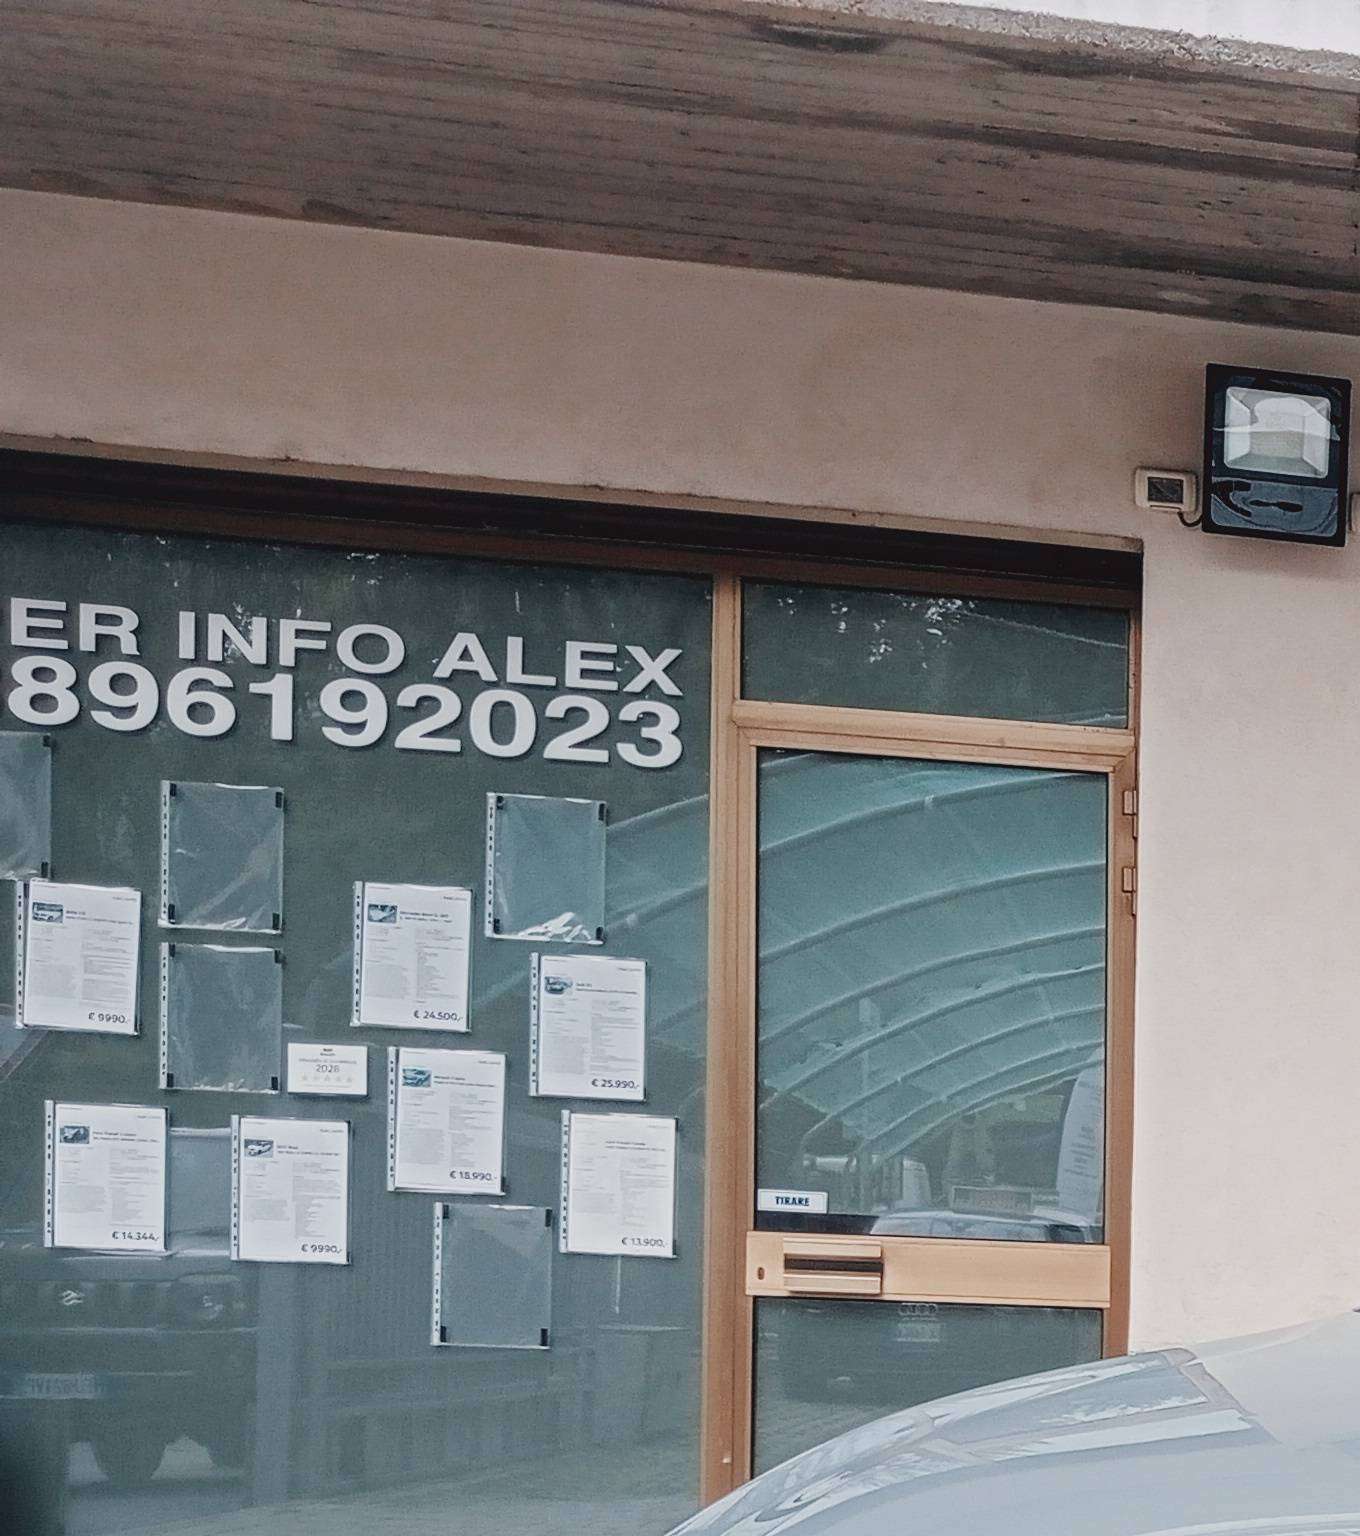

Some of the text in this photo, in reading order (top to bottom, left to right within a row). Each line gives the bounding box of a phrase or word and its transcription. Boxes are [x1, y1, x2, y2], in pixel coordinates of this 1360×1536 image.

[11, 597, 684, 697] ER INFO ALEX
[8, 655, 684, 769] 896192023
[591, 1078, 599, 1088] €
[449, 1170, 457, 1180] €
[775, 1196, 810, 1207] TIRARE
[301, 1244, 308, 1253] €
